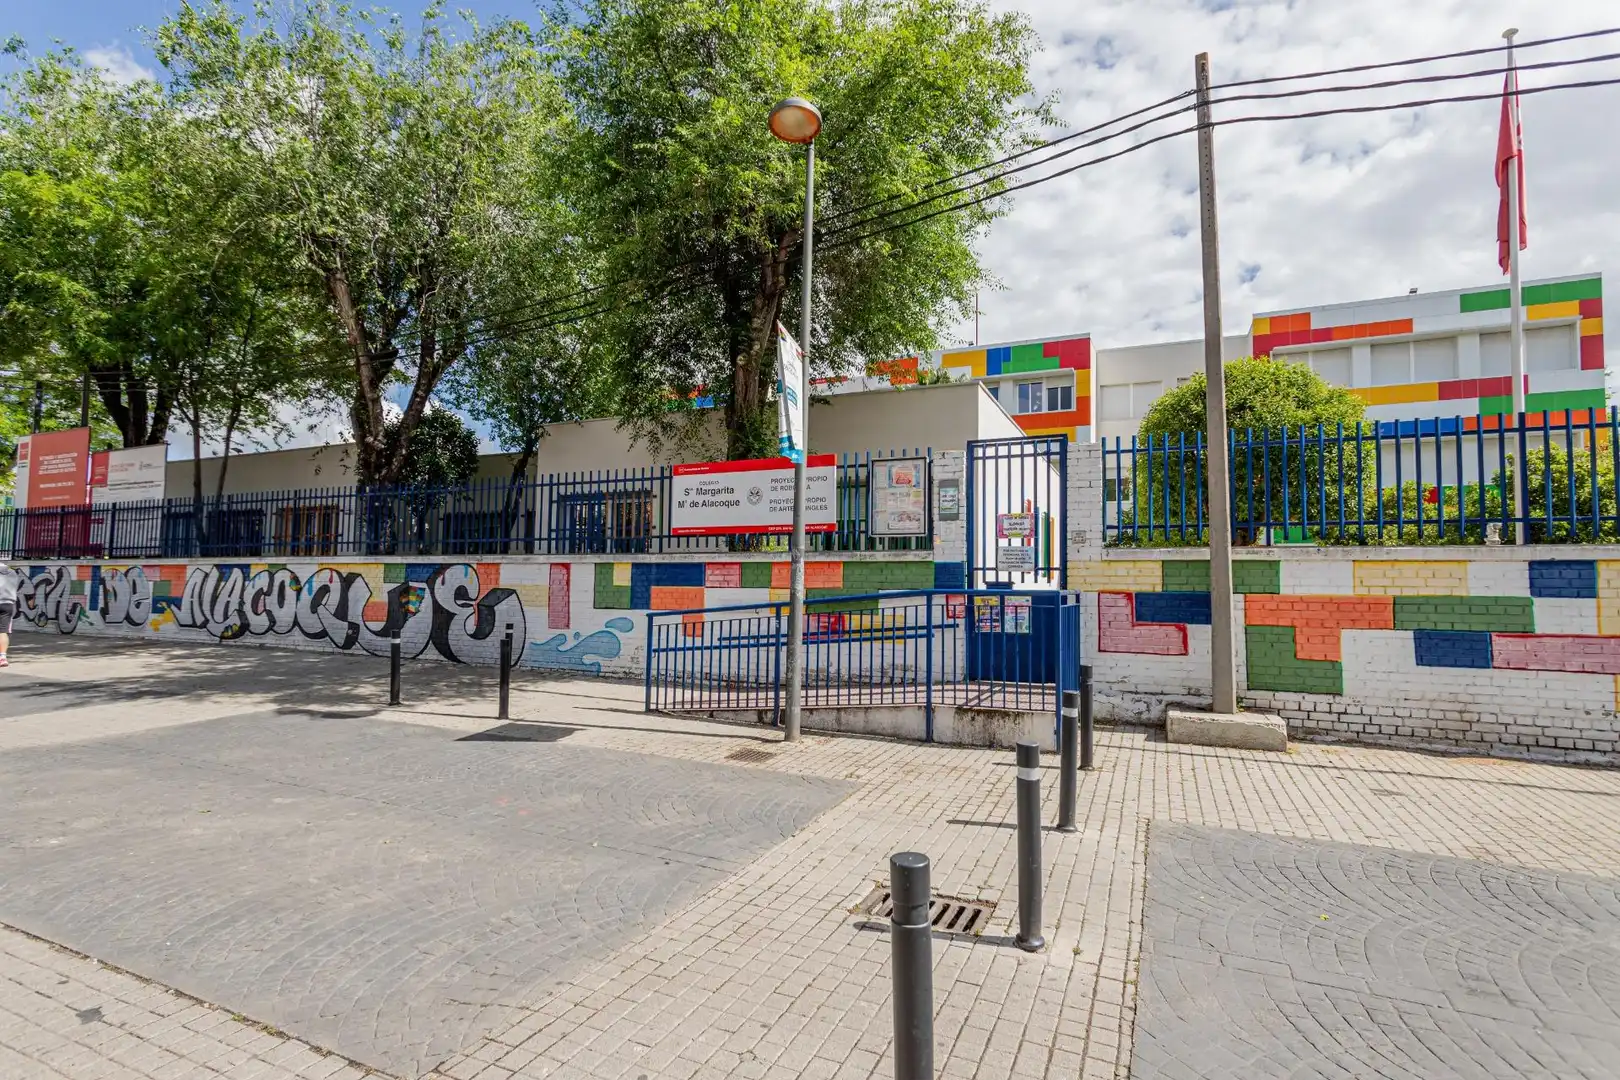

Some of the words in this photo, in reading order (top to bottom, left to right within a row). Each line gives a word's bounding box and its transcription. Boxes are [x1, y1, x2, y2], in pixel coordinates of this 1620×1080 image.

[806, 475, 828, 483] ROPIO
[695, 486, 735, 497] Margarita
[689, 500, 700, 508] de
[701, 499, 741, 509] Alacoque
